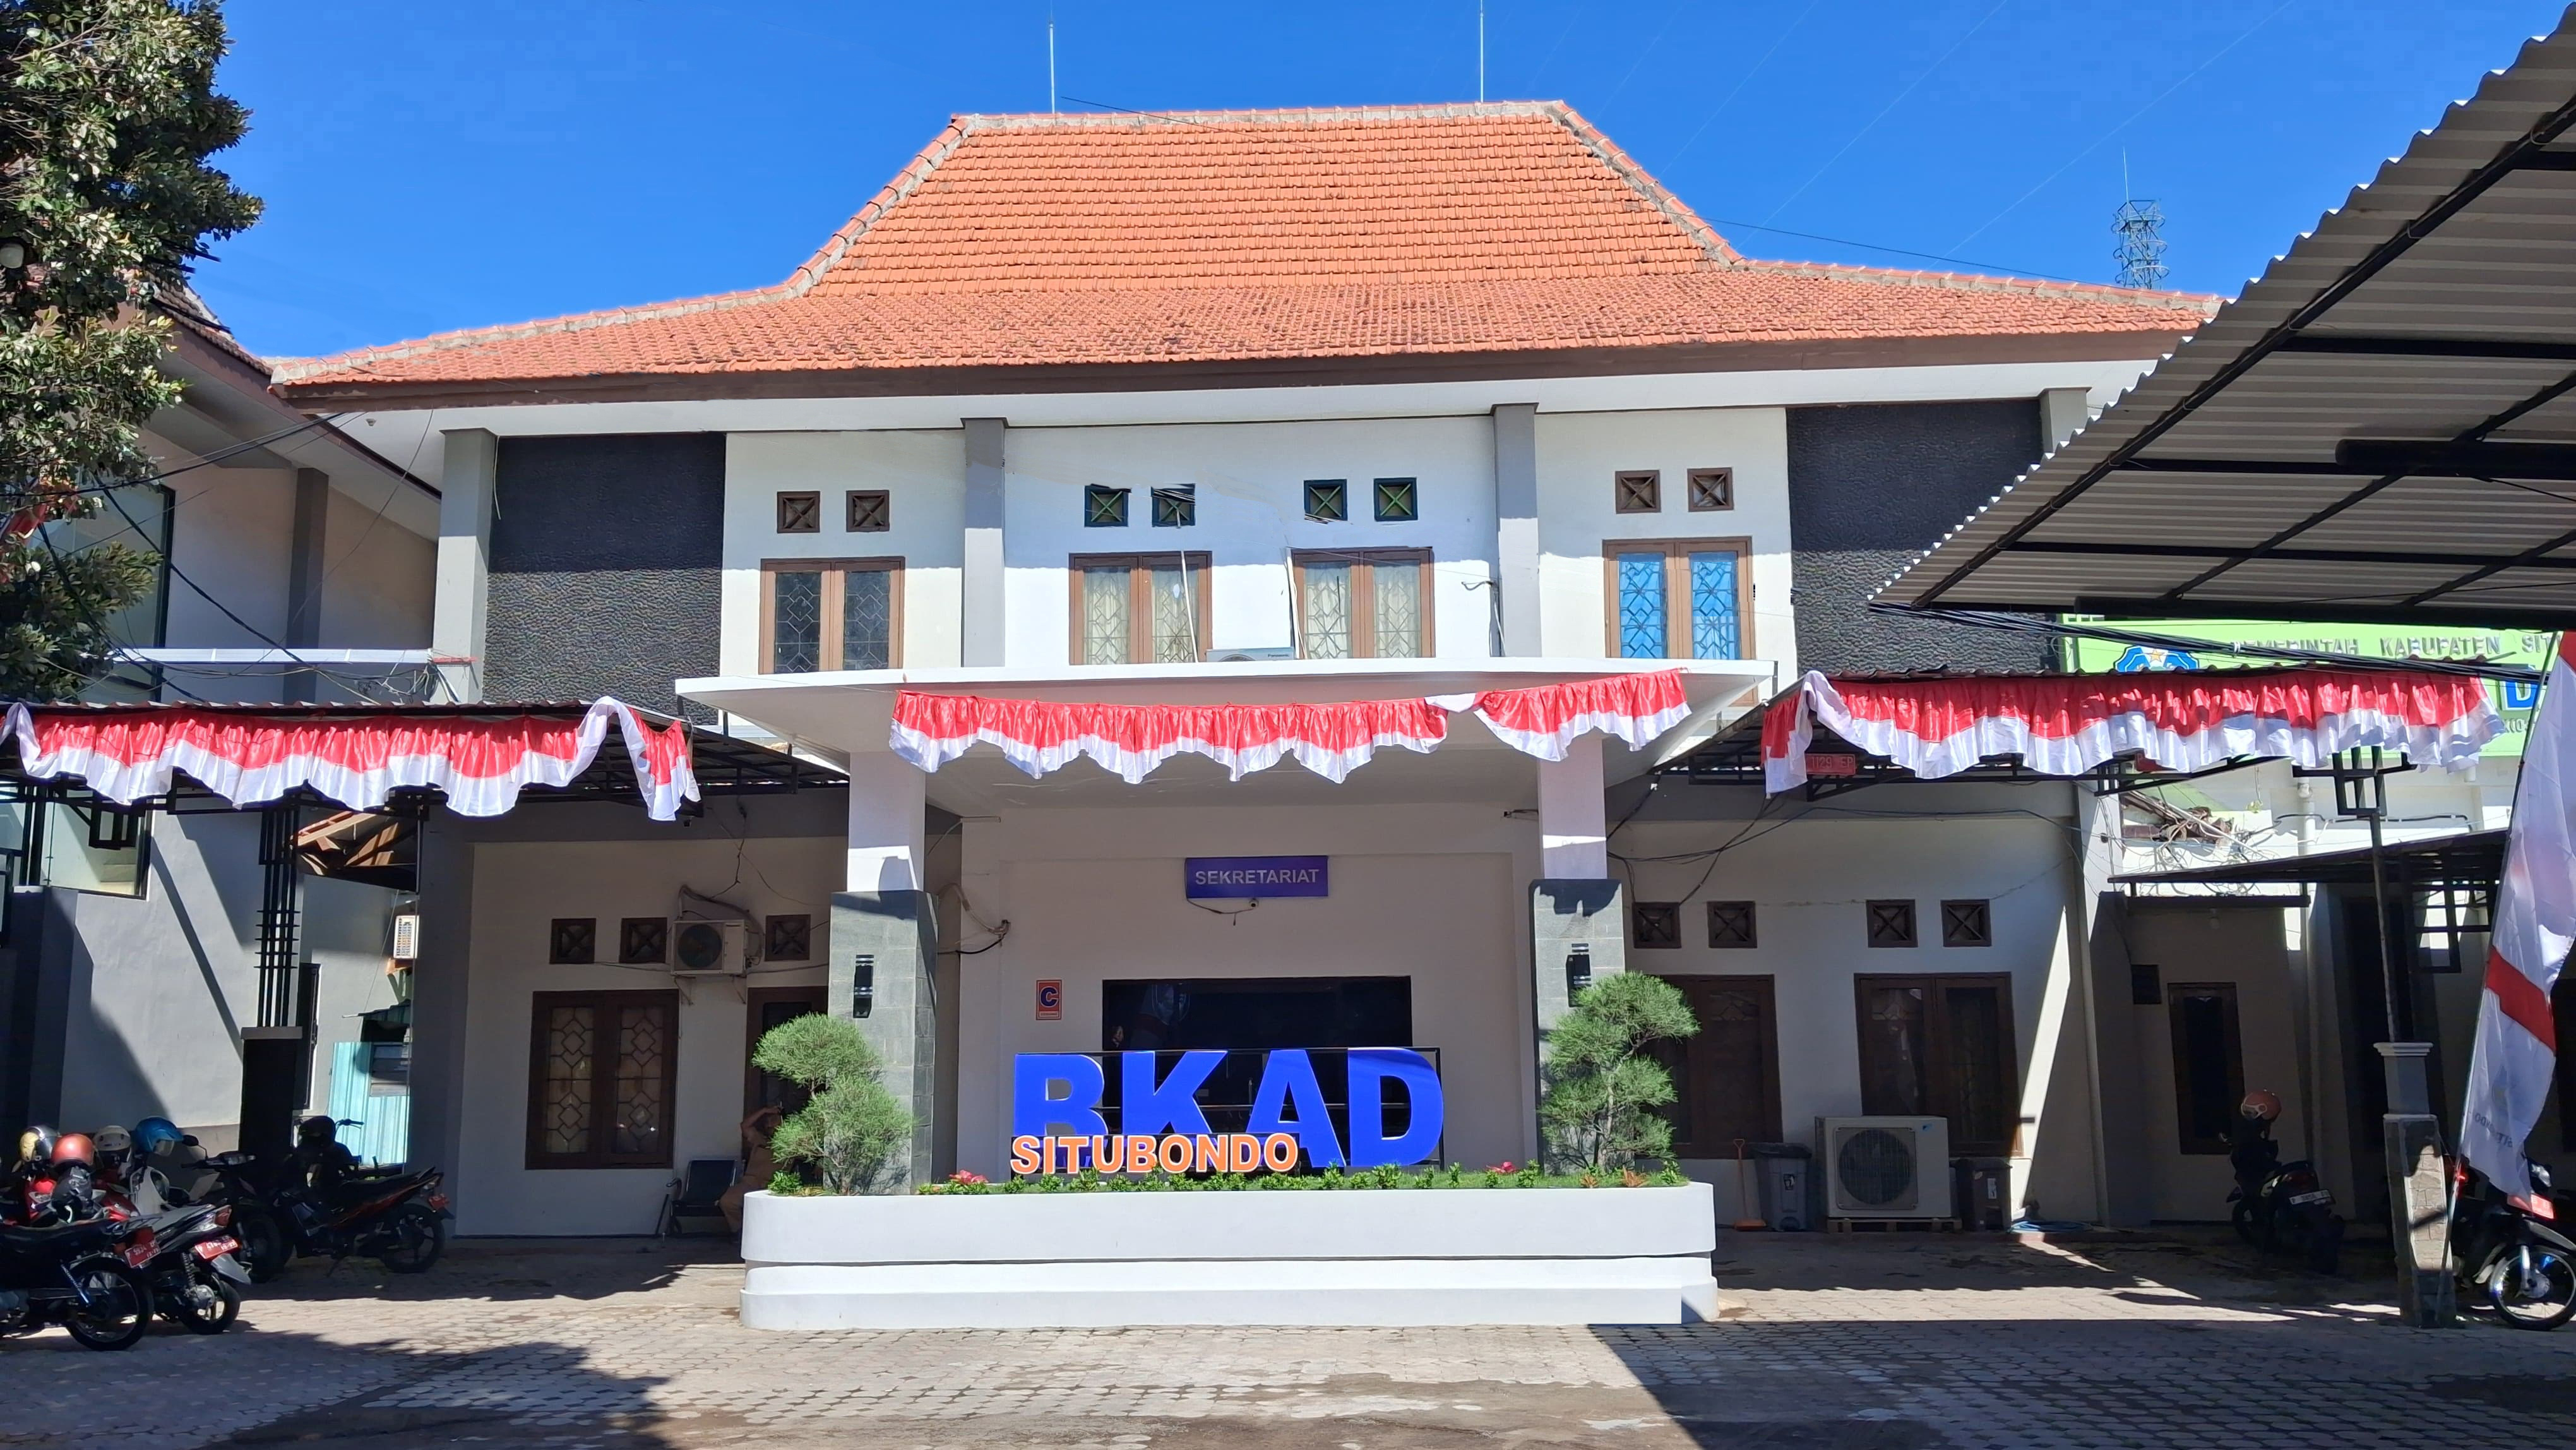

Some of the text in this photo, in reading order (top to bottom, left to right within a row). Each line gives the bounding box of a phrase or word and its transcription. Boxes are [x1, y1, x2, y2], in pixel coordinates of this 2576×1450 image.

[2380, 637, 2500, 656] KABUPATEN
[1195, 869, 1319, 885] SEKRETARIAT
[1040, 986, 1059, 1008] C
[1013, 1046, 1444, 1168] BKAD
[1010, 1132, 1299, 1174] SITUBONDO
